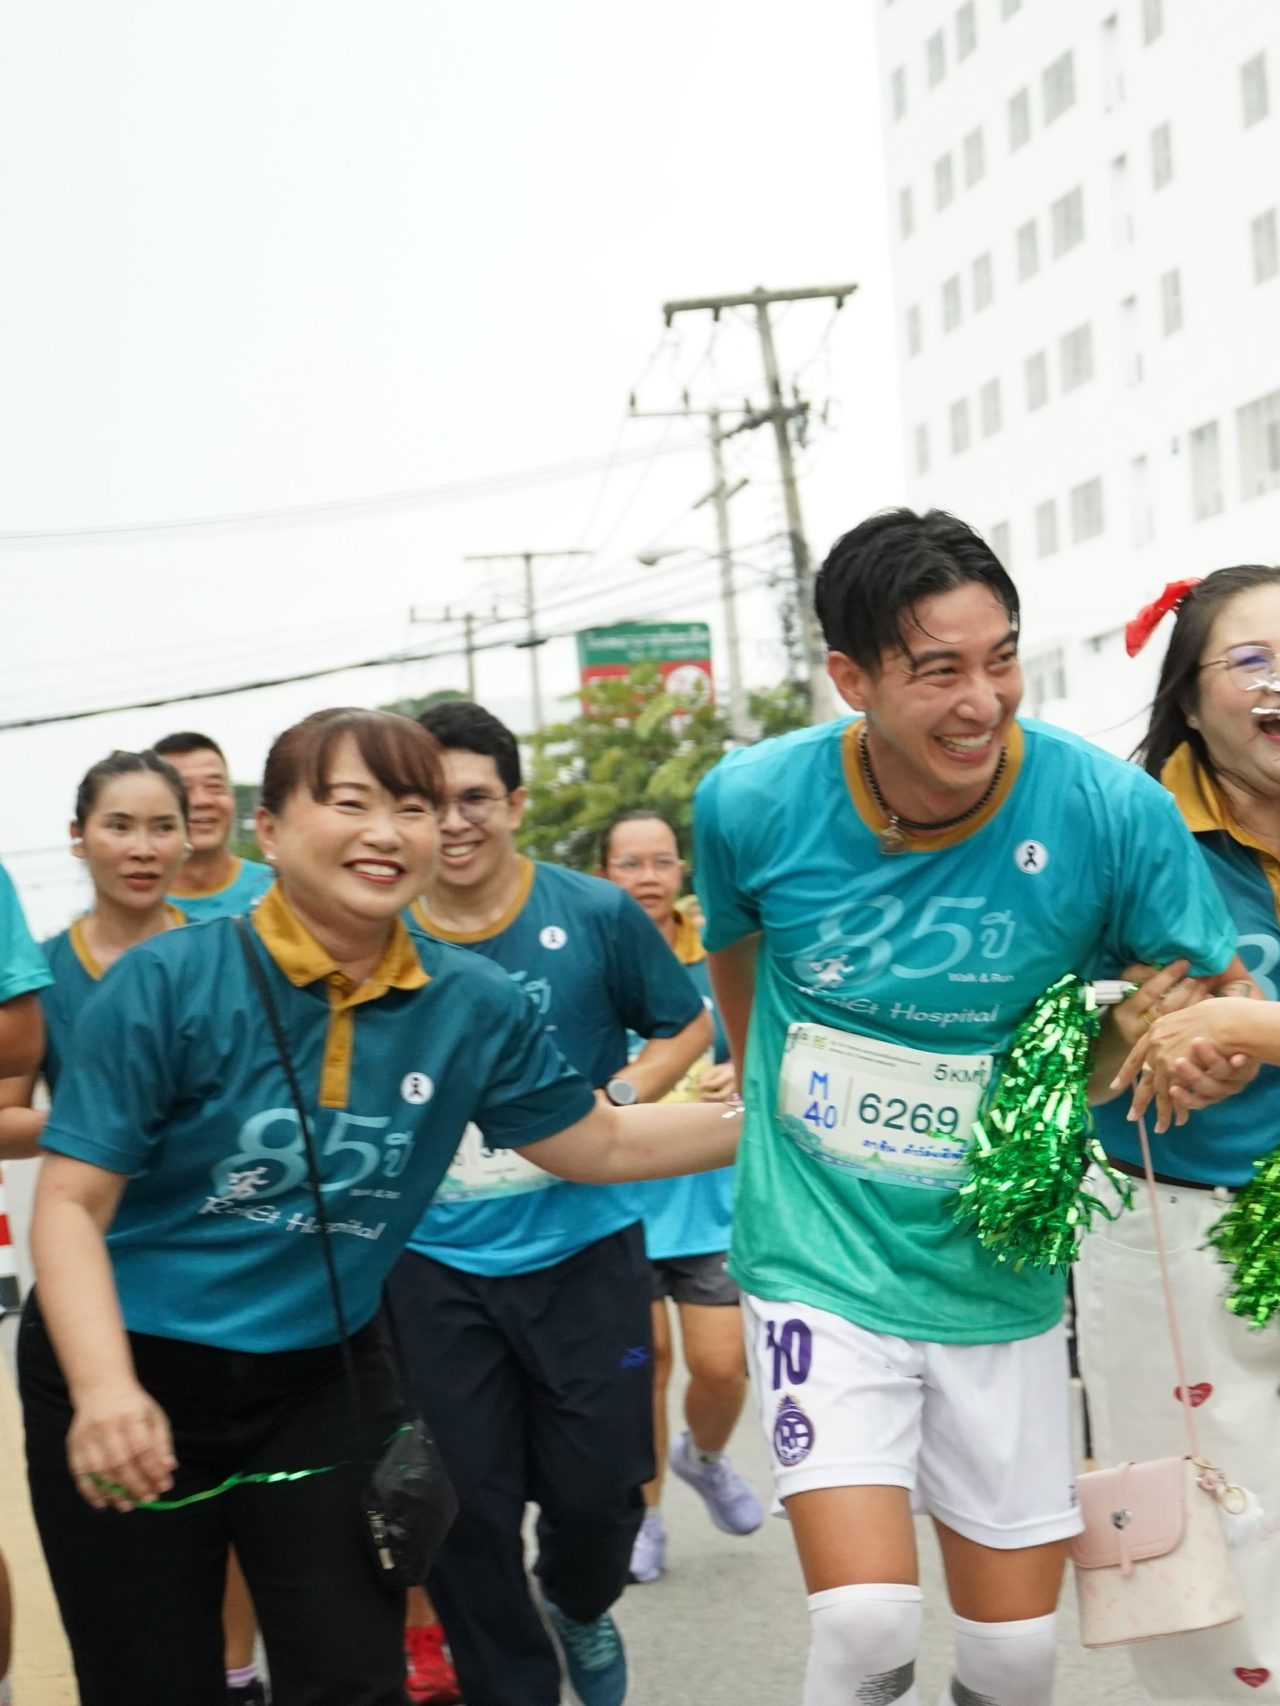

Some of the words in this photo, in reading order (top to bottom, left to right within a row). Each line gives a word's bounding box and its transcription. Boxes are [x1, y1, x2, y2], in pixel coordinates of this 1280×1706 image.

[889, 1002, 1000, 1028] Hospital
[808, 1070, 830, 1101] M
[802, 1100, 838, 1130] 40
[857, 1092, 960, 1136] 6269
